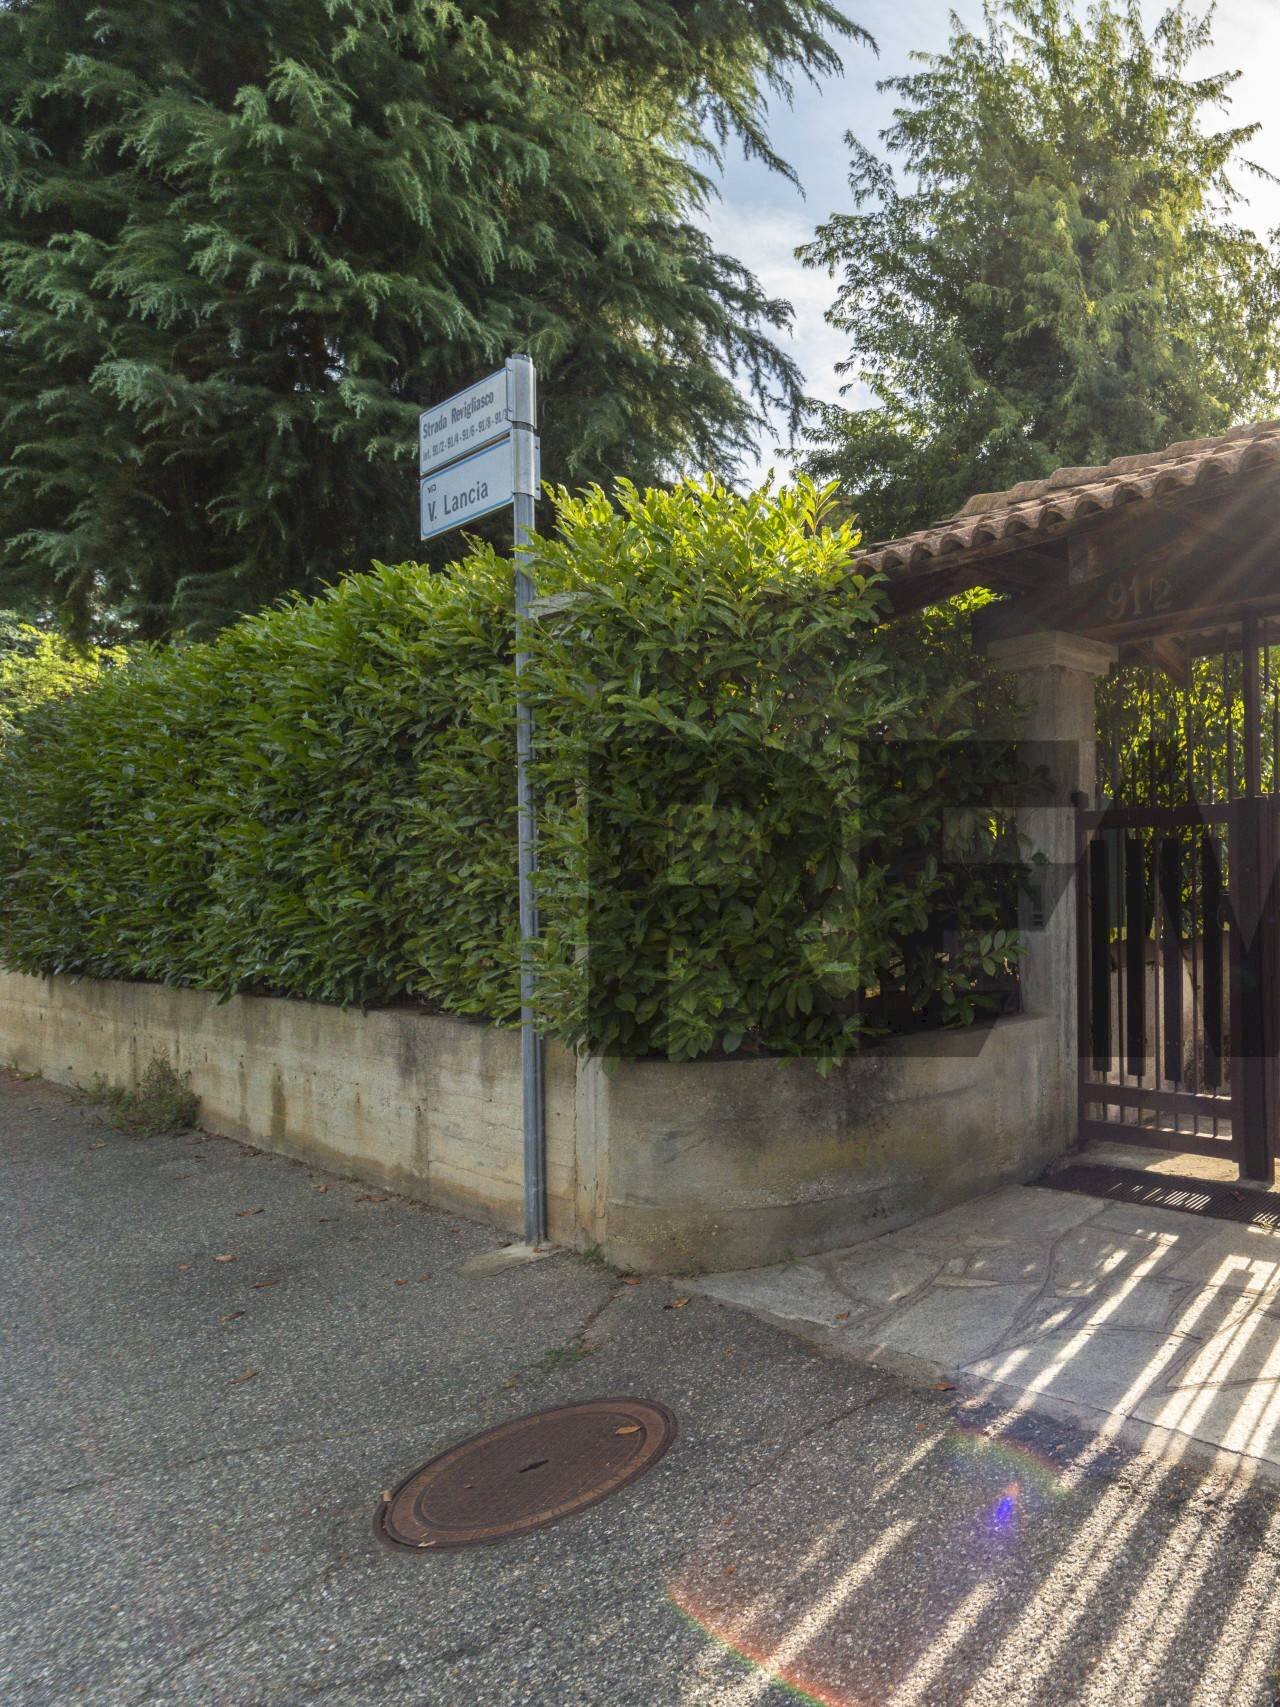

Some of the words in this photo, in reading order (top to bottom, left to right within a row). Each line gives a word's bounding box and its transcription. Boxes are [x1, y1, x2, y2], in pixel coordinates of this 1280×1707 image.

[423, 415, 447, 439] Strada
[451, 392, 494, 424] Revigliasco
[428, 501, 437, 522] V.
[444, 481, 488, 515] Lancia
